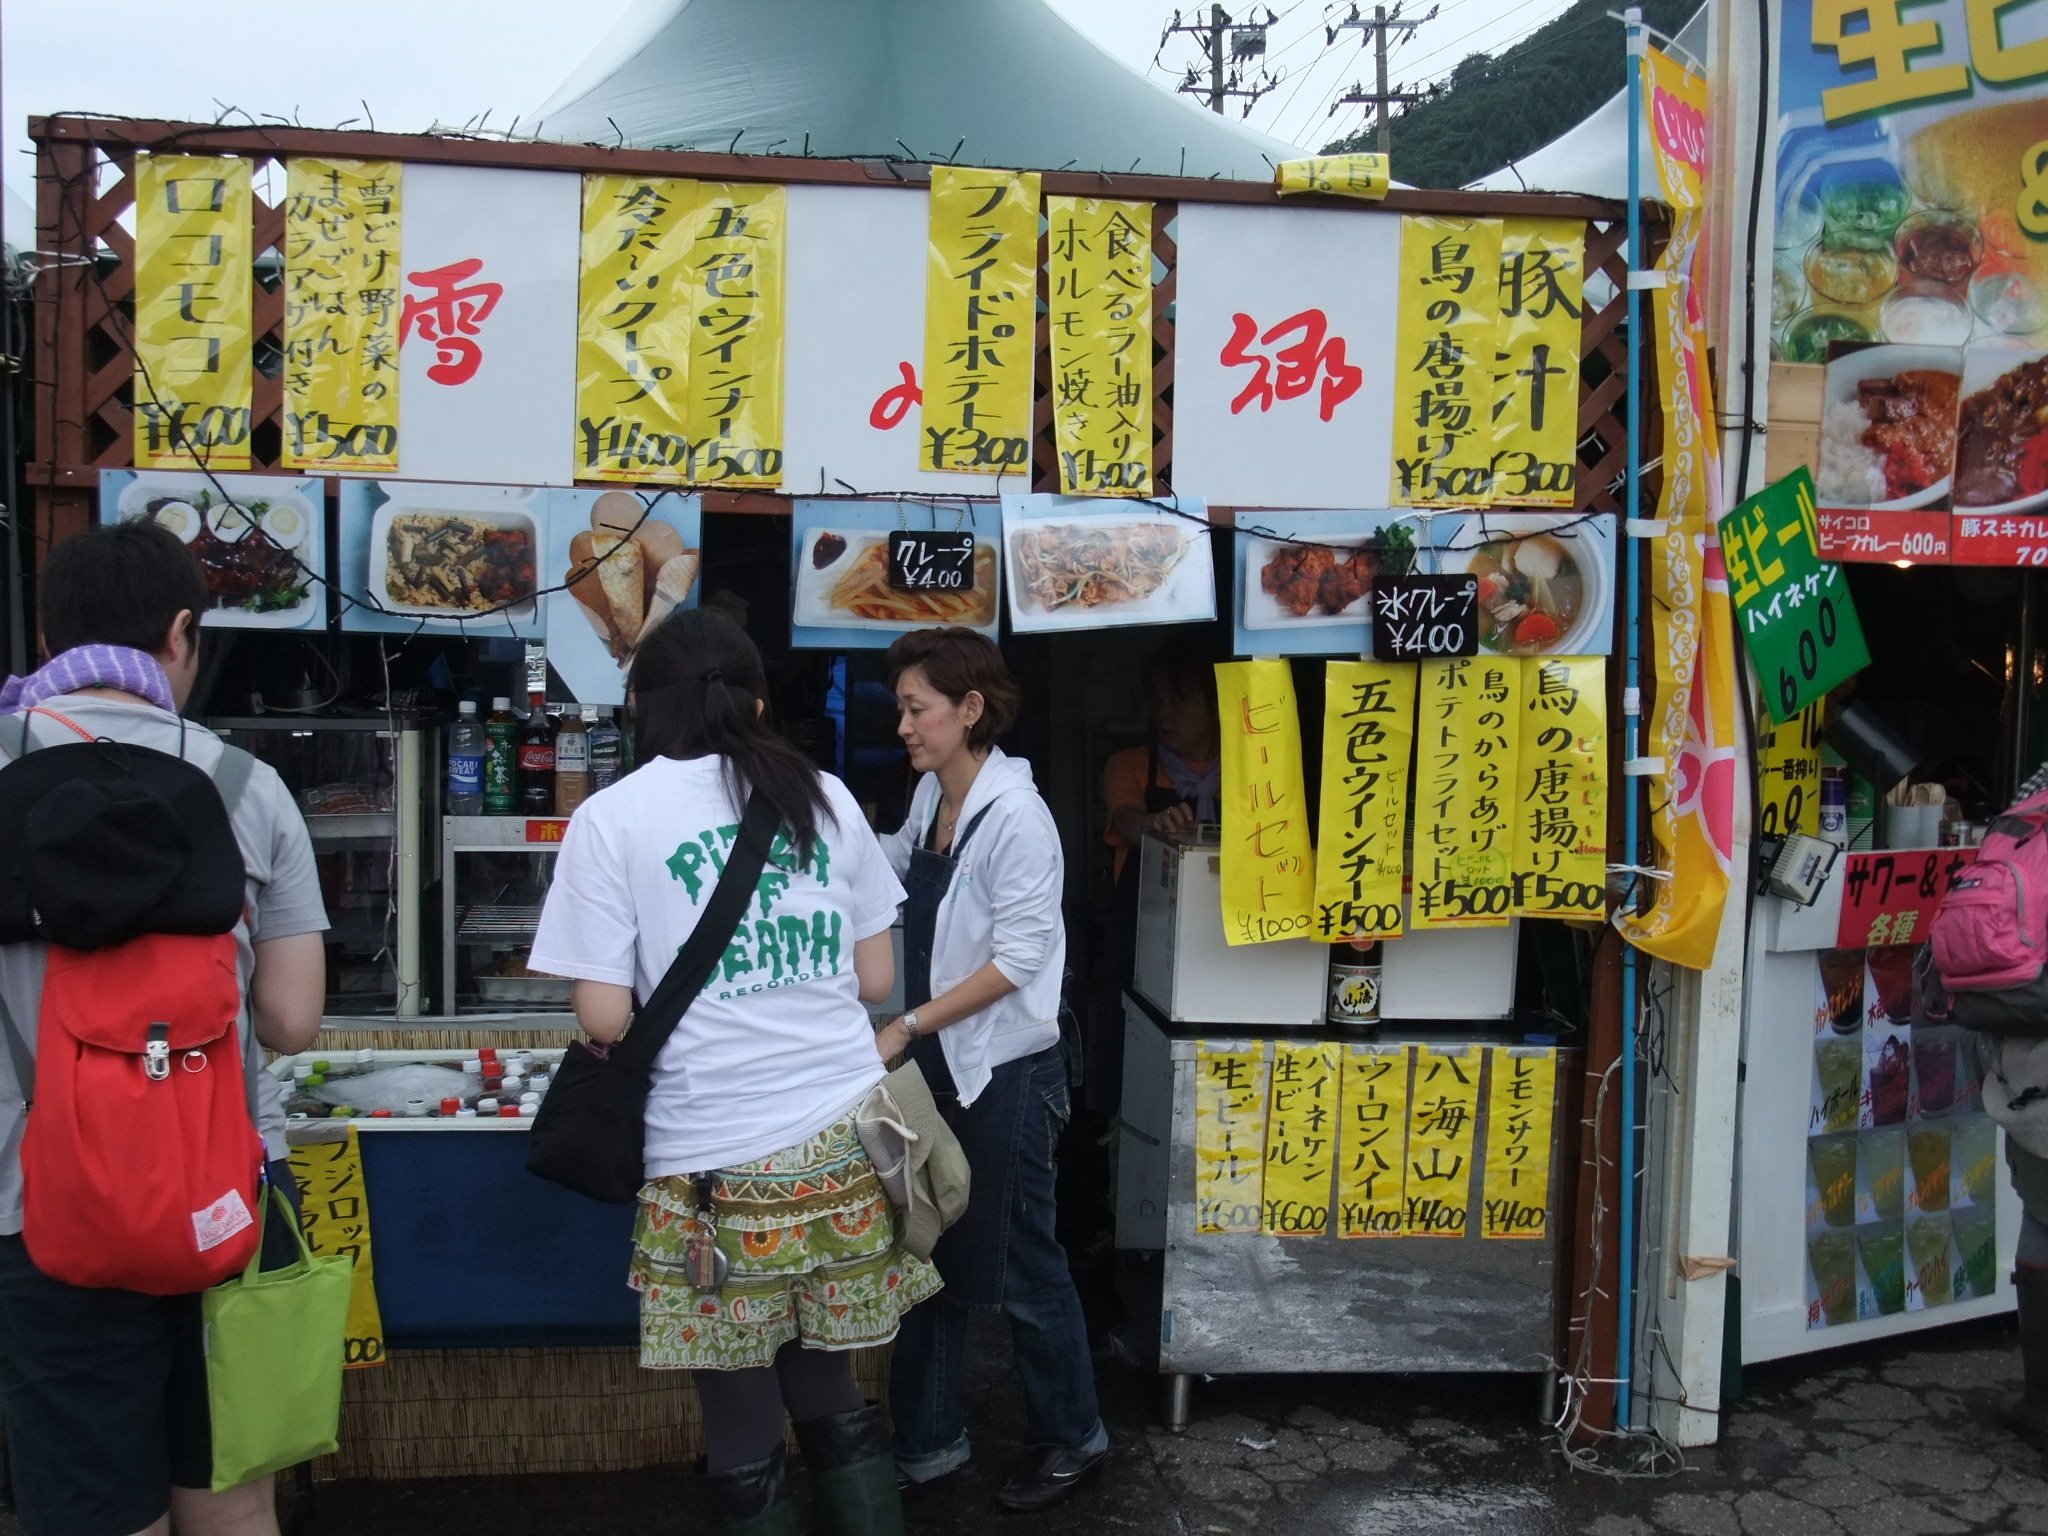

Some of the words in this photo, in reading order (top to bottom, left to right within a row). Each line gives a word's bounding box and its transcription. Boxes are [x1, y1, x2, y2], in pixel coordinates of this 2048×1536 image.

[165, 178, 226, 373] ロコモコ
[285, 190, 317, 397] カラアゲ付き
[314, 169, 354, 356] まぜごはん
[358, 176, 399, 400] 雪どけ野菜の
[400, 258, 503, 386] 雪
[694, 204, 767, 438] 五色ウインナー
[943, 186, 1016, 428] フライドポテト
[1052, 218, 1098, 441] ホルモン焼き
[1093, 211, 1147, 460] 食べるラー油入り
[1494, 247, 1582, 432] 豚汁
[1220, 308, 1362, 422] 郷
[1413, 235, 1478, 461] 鳥の唐揚げ
[140, 402, 251, 454] ¥600
[287, 411, 397, 459] ¥500
[580, 416, 687, 469] ¥400
[688, 438, 783, 480] ¥500
[924, 426, 1028, 469] ¥300
[1062, 449, 1147, 490] ¥500
[1395, 458, 1489, 499] ¥500
[897, 538, 972, 567] クレープ
[1722, 482, 1818, 609] 生ビール
[1819, 515, 1870, 531] サイコロ
[903, 566, 962, 588] ¥400
[1377, 580, 1478, 621] 氷クレープ
[1746, 565, 1838, 633] ハイネケン
[1387, 623, 1464, 656] ¥400
[1340, 679, 1396, 901] 五色ウインナー
[1428, 659, 1469, 881] ポテトフライセット
[1471, 668, 1509, 853] 鳥のからあげ
[1525, 661, 1584, 873] 鳥の唐揚げ
[1318, 902, 1401, 936] ¥500
[1419, 880, 1510, 917] ¥500
[1510, 871, 1606, 911] ¥500
[678, 910, 842, 989] EATH
[1238, 910, 1311, 941] ¥1000
[1867, 910, 1919, 946] 各種
[720, 970, 824, 1000] RECORDS
[1211, 1058, 1253, 1183] 生ビール
[1266, 1054, 1302, 1166] 生ビール
[1303, 1054, 1336, 1182] ハイネケン
[1353, 1059, 1393, 1200] ウーロンハイ
[1413, 1056, 1471, 1182] 八海山
[1505, 1057, 1533, 1187] レモンサワー
[1810, 1074, 1859, 1128] ハイボール
[1199, 1198, 1262, 1231] ¥600
[1265, 1200, 1328, 1232] ¥600
[1341, 1202, 1401, 1232] ¥400
[1402, 1197, 1466, 1231] ¥400
[1485, 1198, 1545, 1231] ¥400
